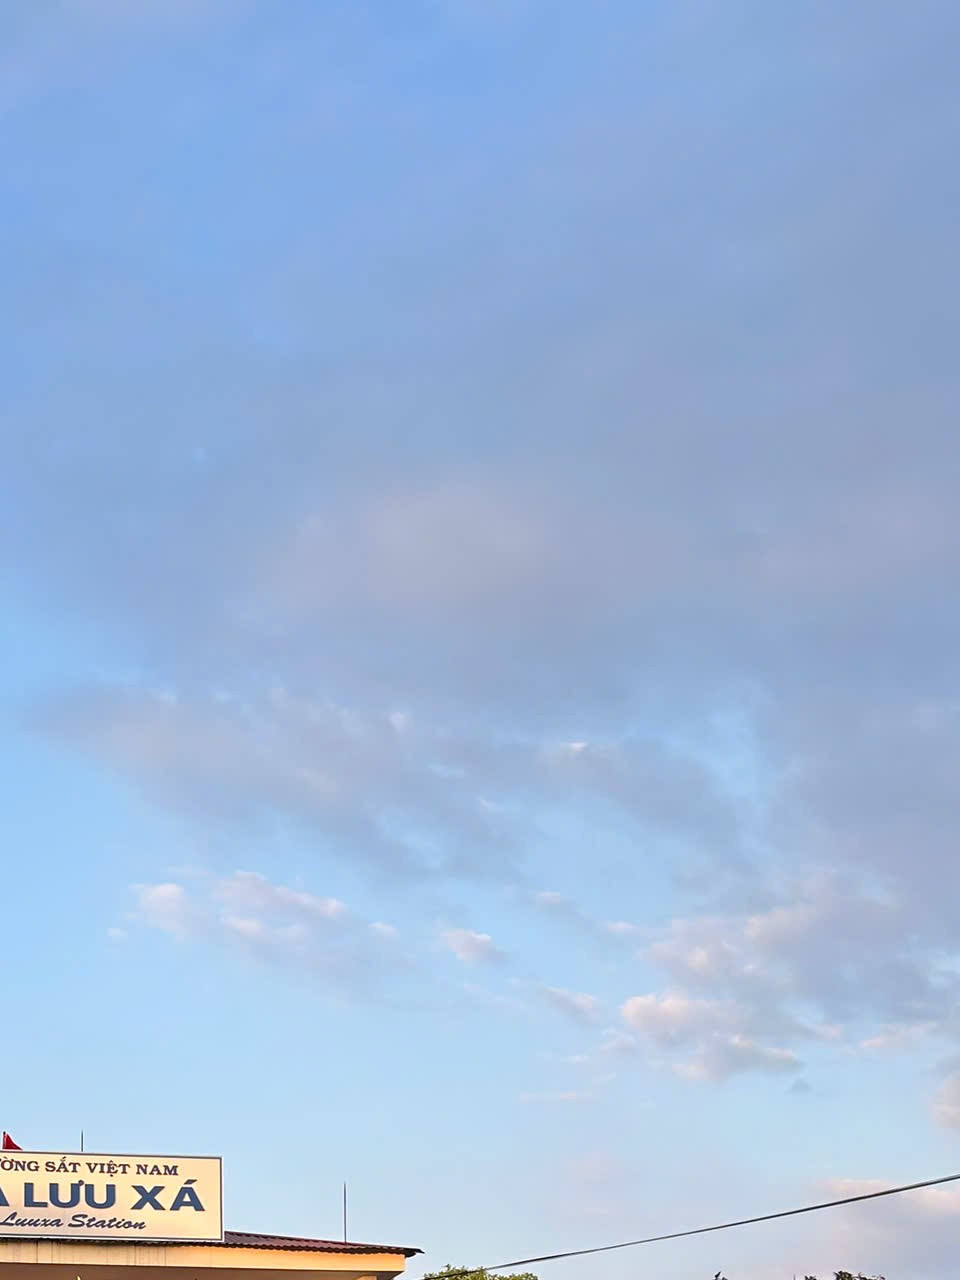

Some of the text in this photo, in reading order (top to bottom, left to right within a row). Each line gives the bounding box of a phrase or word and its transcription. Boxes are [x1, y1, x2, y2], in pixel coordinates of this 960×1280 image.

[45, 1156, 81, 1173] SẮT
[86, 1160, 131, 1177] VIỆT
[136, 1164, 179, 1176] NAM
[23, 1179, 116, 1209] LƯU
[130, 1179, 206, 1212] XÁ
[67, 1214, 146, 1230] Station
